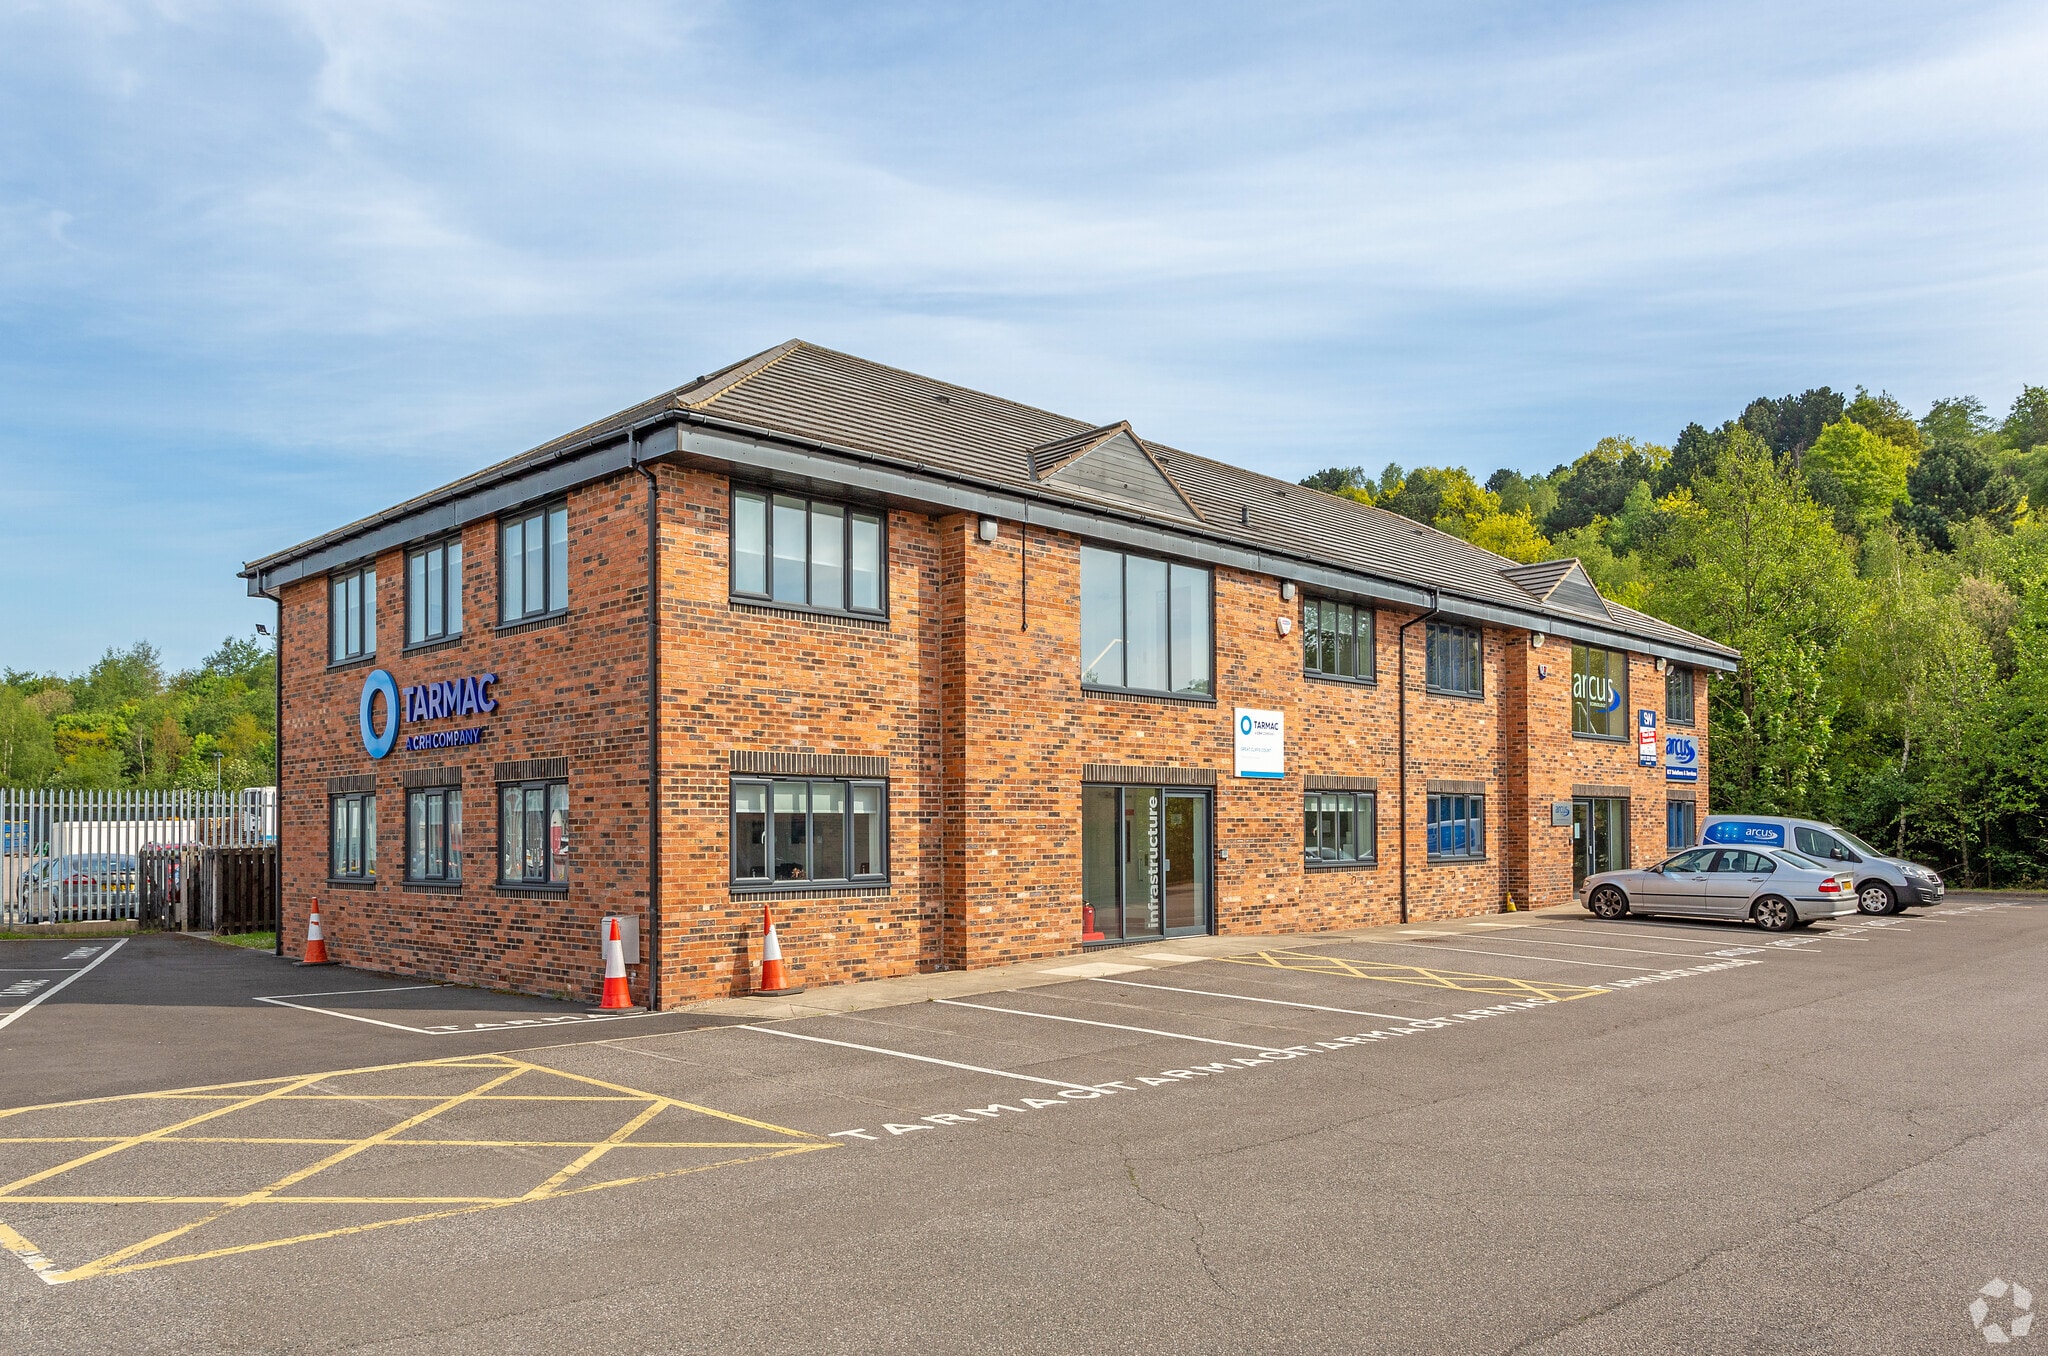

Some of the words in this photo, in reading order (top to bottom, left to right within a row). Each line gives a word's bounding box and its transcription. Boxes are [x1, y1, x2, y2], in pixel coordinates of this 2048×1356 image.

[402, 673, 499, 723] TARMAC
[1573, 673, 1613, 702] arcus
[406, 735, 413, 751] A
[413, 733, 432, 751] CRH
[432, 727, 482, 749] COMPANY
[1254, 720, 1279, 731] TARMAC
[1666, 737, 1691, 756] arcus
[1745, 827, 1773, 837] arcus
[1147, 795, 1158, 929] infrastructure
[1428, 998, 1559, 1025] TARMAC
[1286, 1021, 1442, 1054] TARMAC
[1095, 1050, 1295, 1092] TARMAC
[827, 1088, 1102, 1141] TARMAC
